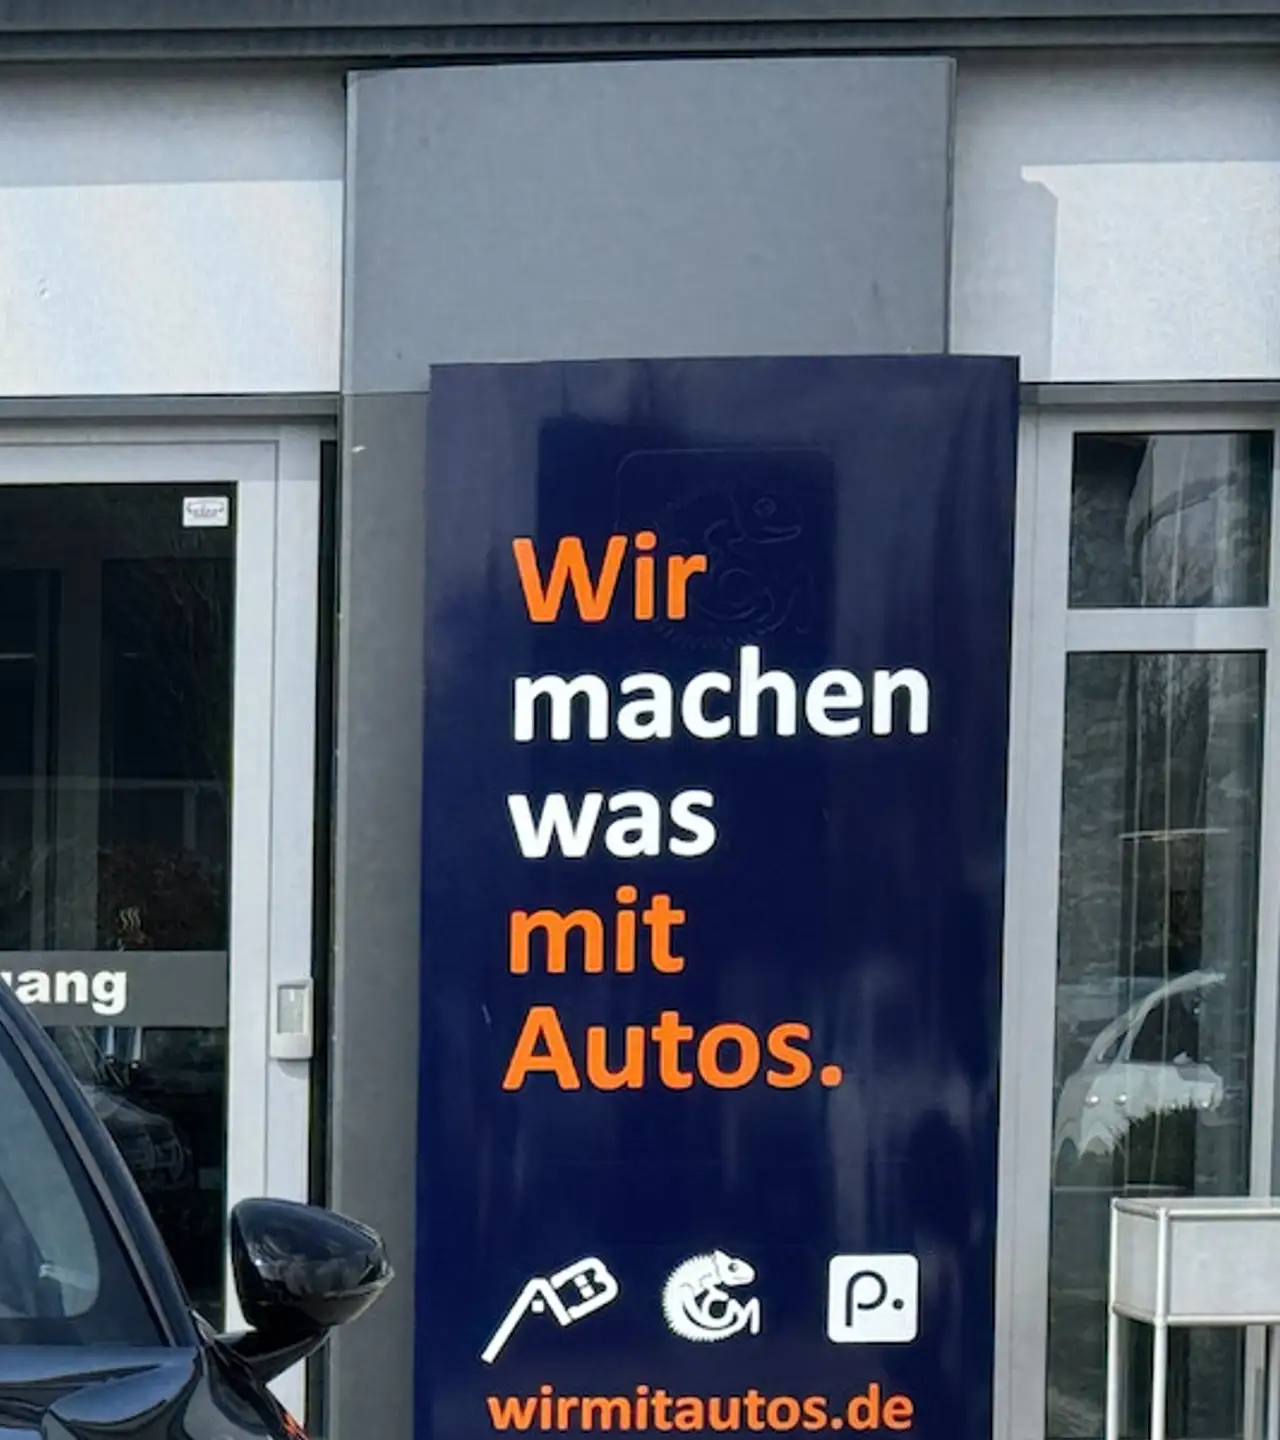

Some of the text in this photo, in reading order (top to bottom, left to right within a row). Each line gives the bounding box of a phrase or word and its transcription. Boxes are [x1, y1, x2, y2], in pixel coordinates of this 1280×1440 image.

[512, 530, 707, 623] Wir
[512, 645, 930, 742] machen
[507, 790, 718, 858] was
[509, 884, 686, 974] mit
[502, 1005, 844, 1091] Autos.
[487, 1383, 915, 1432] wirmitautos.de
